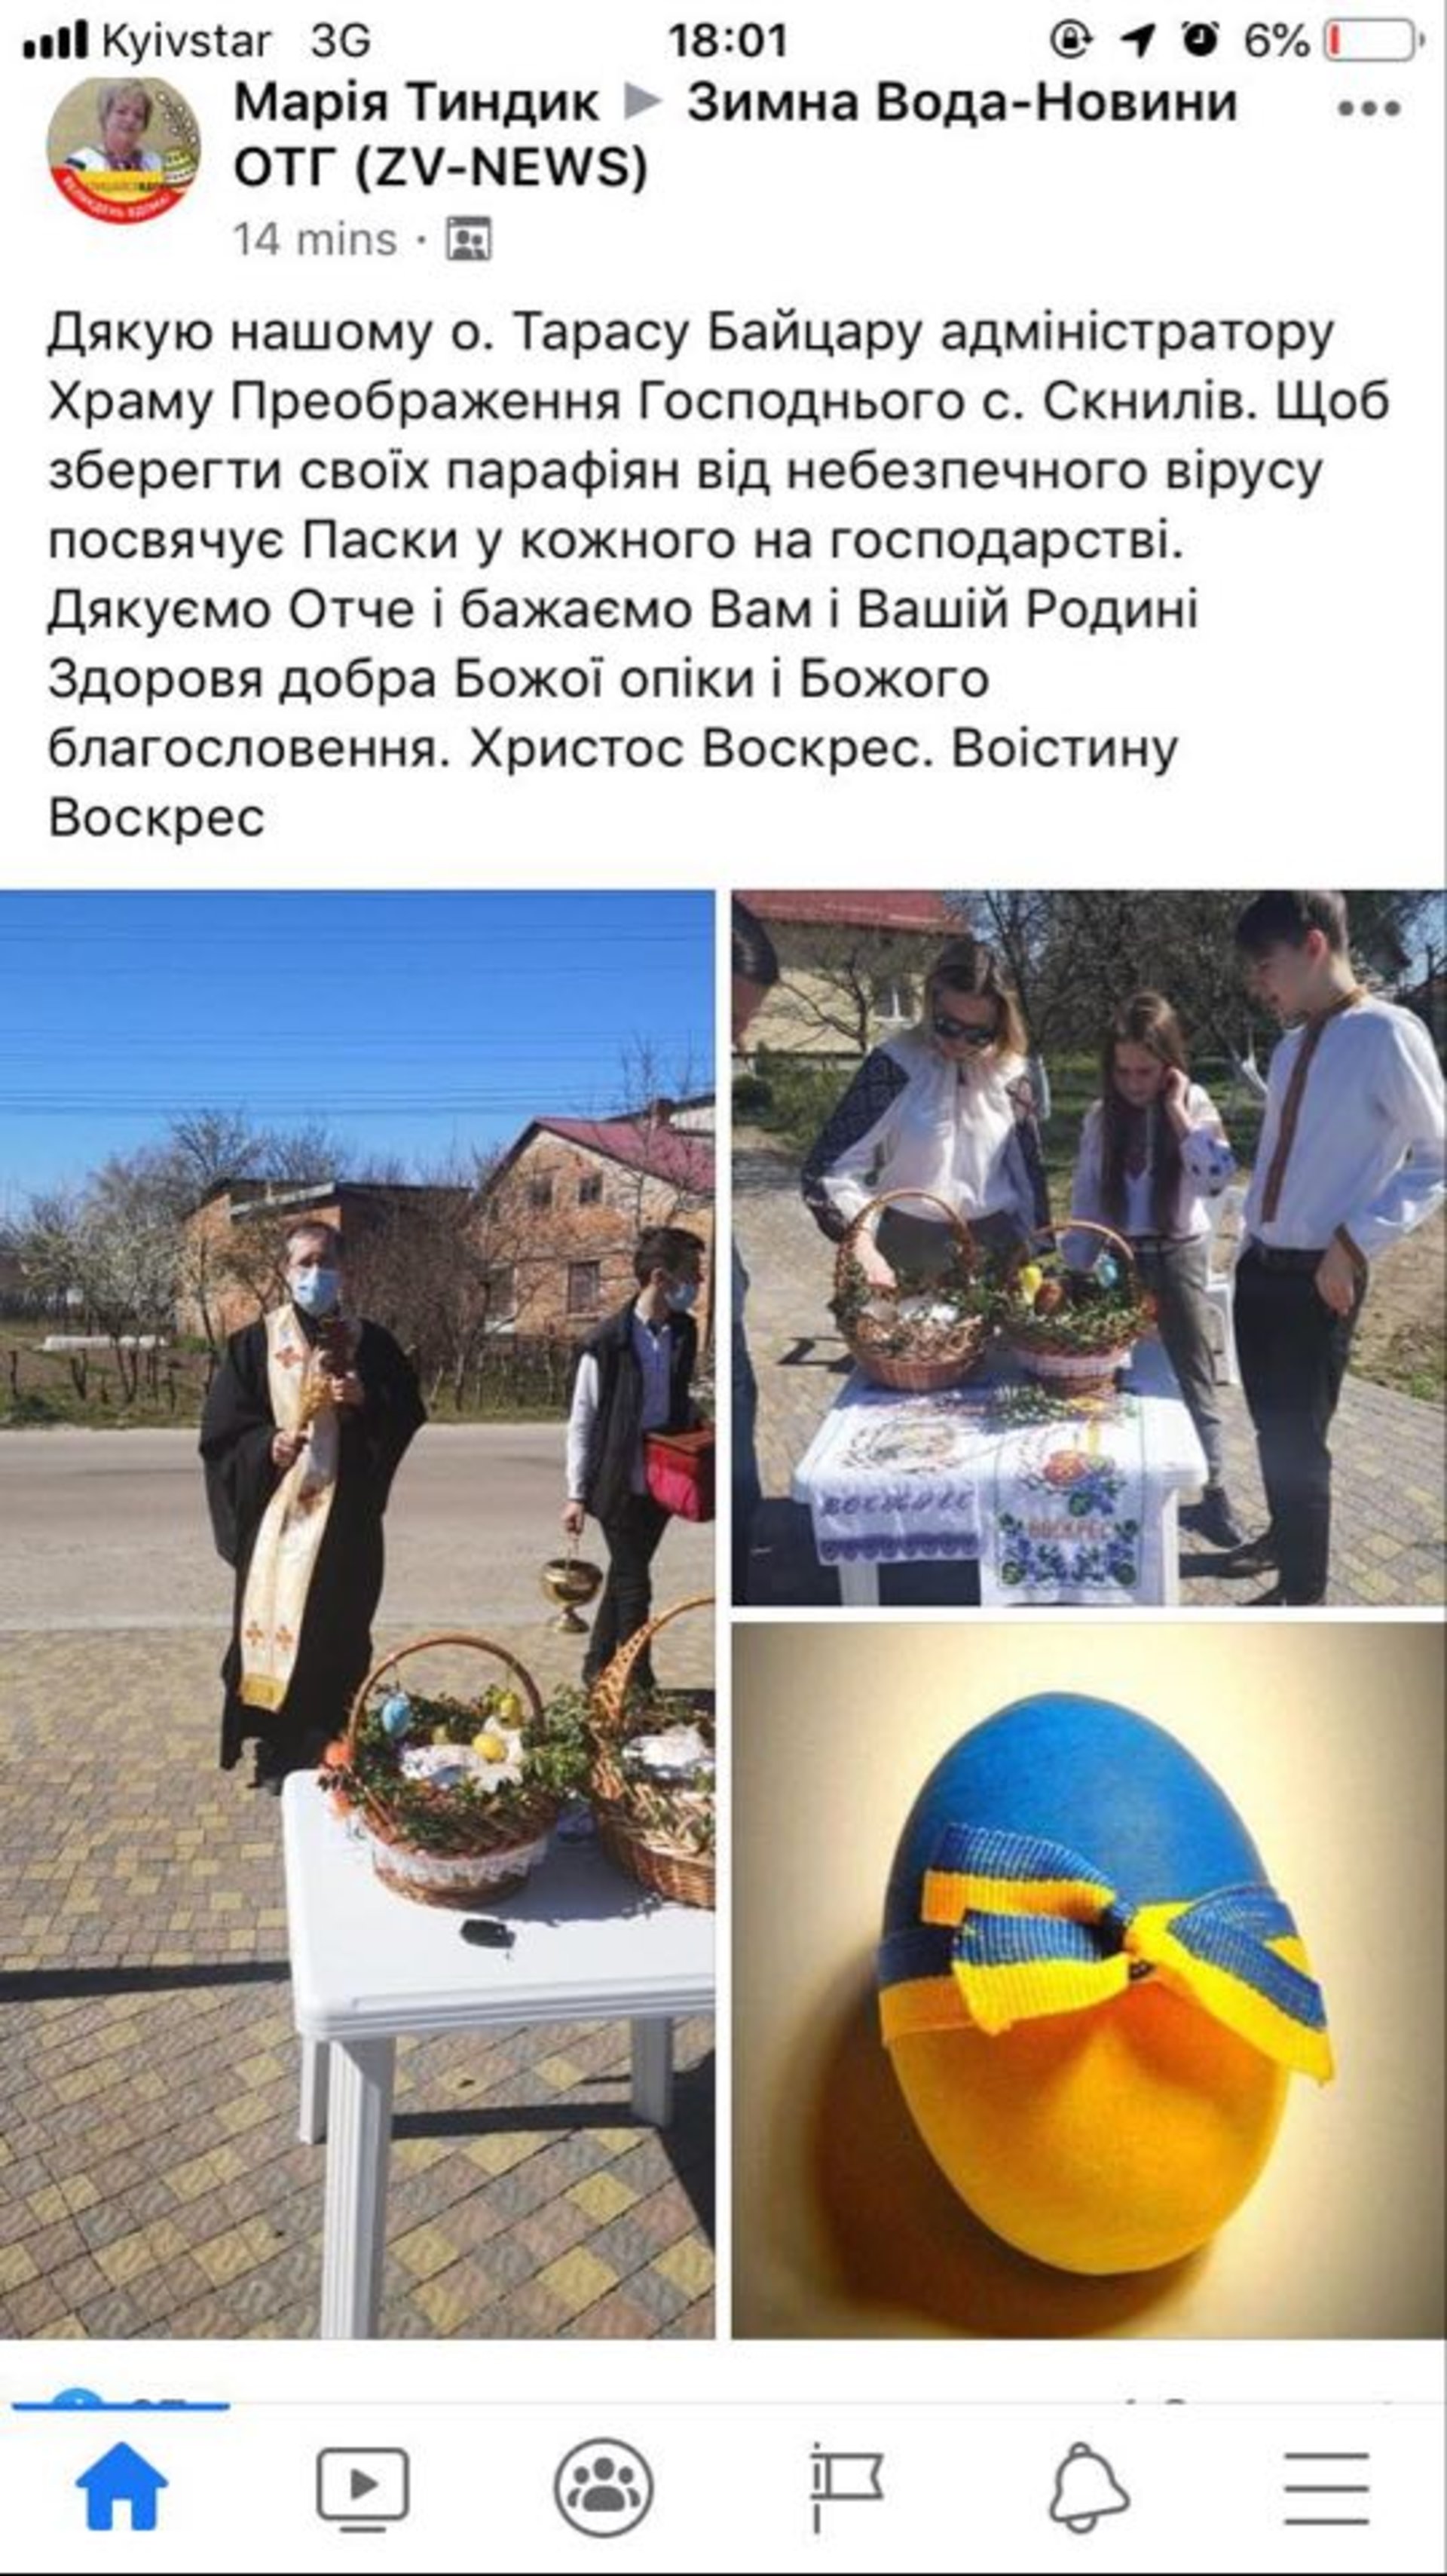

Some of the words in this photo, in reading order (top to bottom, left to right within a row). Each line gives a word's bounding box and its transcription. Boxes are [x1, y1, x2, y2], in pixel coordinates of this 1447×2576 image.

[102, 23, 273, 66] Kyivstar
[311, 22, 371, 59] 3G
[668, 22, 785, 58] 18:01
[1245, 23, 1310, 59] 6%
[235, 78, 387, 131] Марія
[404, 80, 600, 129] Тиндик
[688, 80, 858, 122] Зимна
[877, 80, 1237, 129] Вода-Новини
[234, 145, 338, 188] ОТГ
[356, 144, 647, 195] (ZV-NEWS)
[234, 222, 280, 256] 14
[298, 220, 396, 256] mins
[46, 310, 213, 361] Дякую
[232, 319, 433, 361] нашому
[451, 320, 493, 351] о.
[512, 310, 690, 361] Тарасу
[709, 308, 923, 361] Байцару
[941, 308, 1335, 361] адміністратору
[49, 380, 214, 430] Храму
[232, 378, 619, 430] Преображення
[640, 380, 965, 427] Господнього
[983, 388, 1023, 421] с.
[1044, 378, 1256, 421] Скнилів.
[1277, 378, 1389, 427] Щоб
[49, 448, 280, 499] зберегти
[300, 447, 429, 490] своїх
[448, 447, 678, 499] парафіян
[699, 447, 771, 497] від
[788, 448, 1147, 490] небезпечного
[1167, 447, 1323, 500] вірусу
[50, 528, 283, 569] посвячує
[304, 518, 457, 559] Паски
[476, 528, 503, 569] у
[522, 528, 736, 559] кожного
[755, 528, 812, 559] на
[832, 517, 1182, 568] господарстві.
[46, 587, 271, 639] Дякуємо
[289, 587, 414, 629] Отче
[434, 587, 442, 628] і
[460, 587, 692, 629] бажаємо
[711, 587, 811, 629] Вам
[831, 587, 839, 628] і
[859, 584, 1008, 629] Вашій
[1028, 587, 1197, 636] Родині
[48, 656, 262, 707] Здоровя
[278, 656, 435, 707] добра
[456, 656, 604, 698] Божої
[620, 656, 754, 698] опіки
[772, 655, 781, 697] і
[801, 657, 990, 698] Божого
[48, 726, 449, 767] благословення.
[470, 726, 684, 777] Христос
[704, 726, 933, 776] Воскрес.
[953, 725, 1179, 777] Воістину
[50, 796, 264, 846] Воскрес
